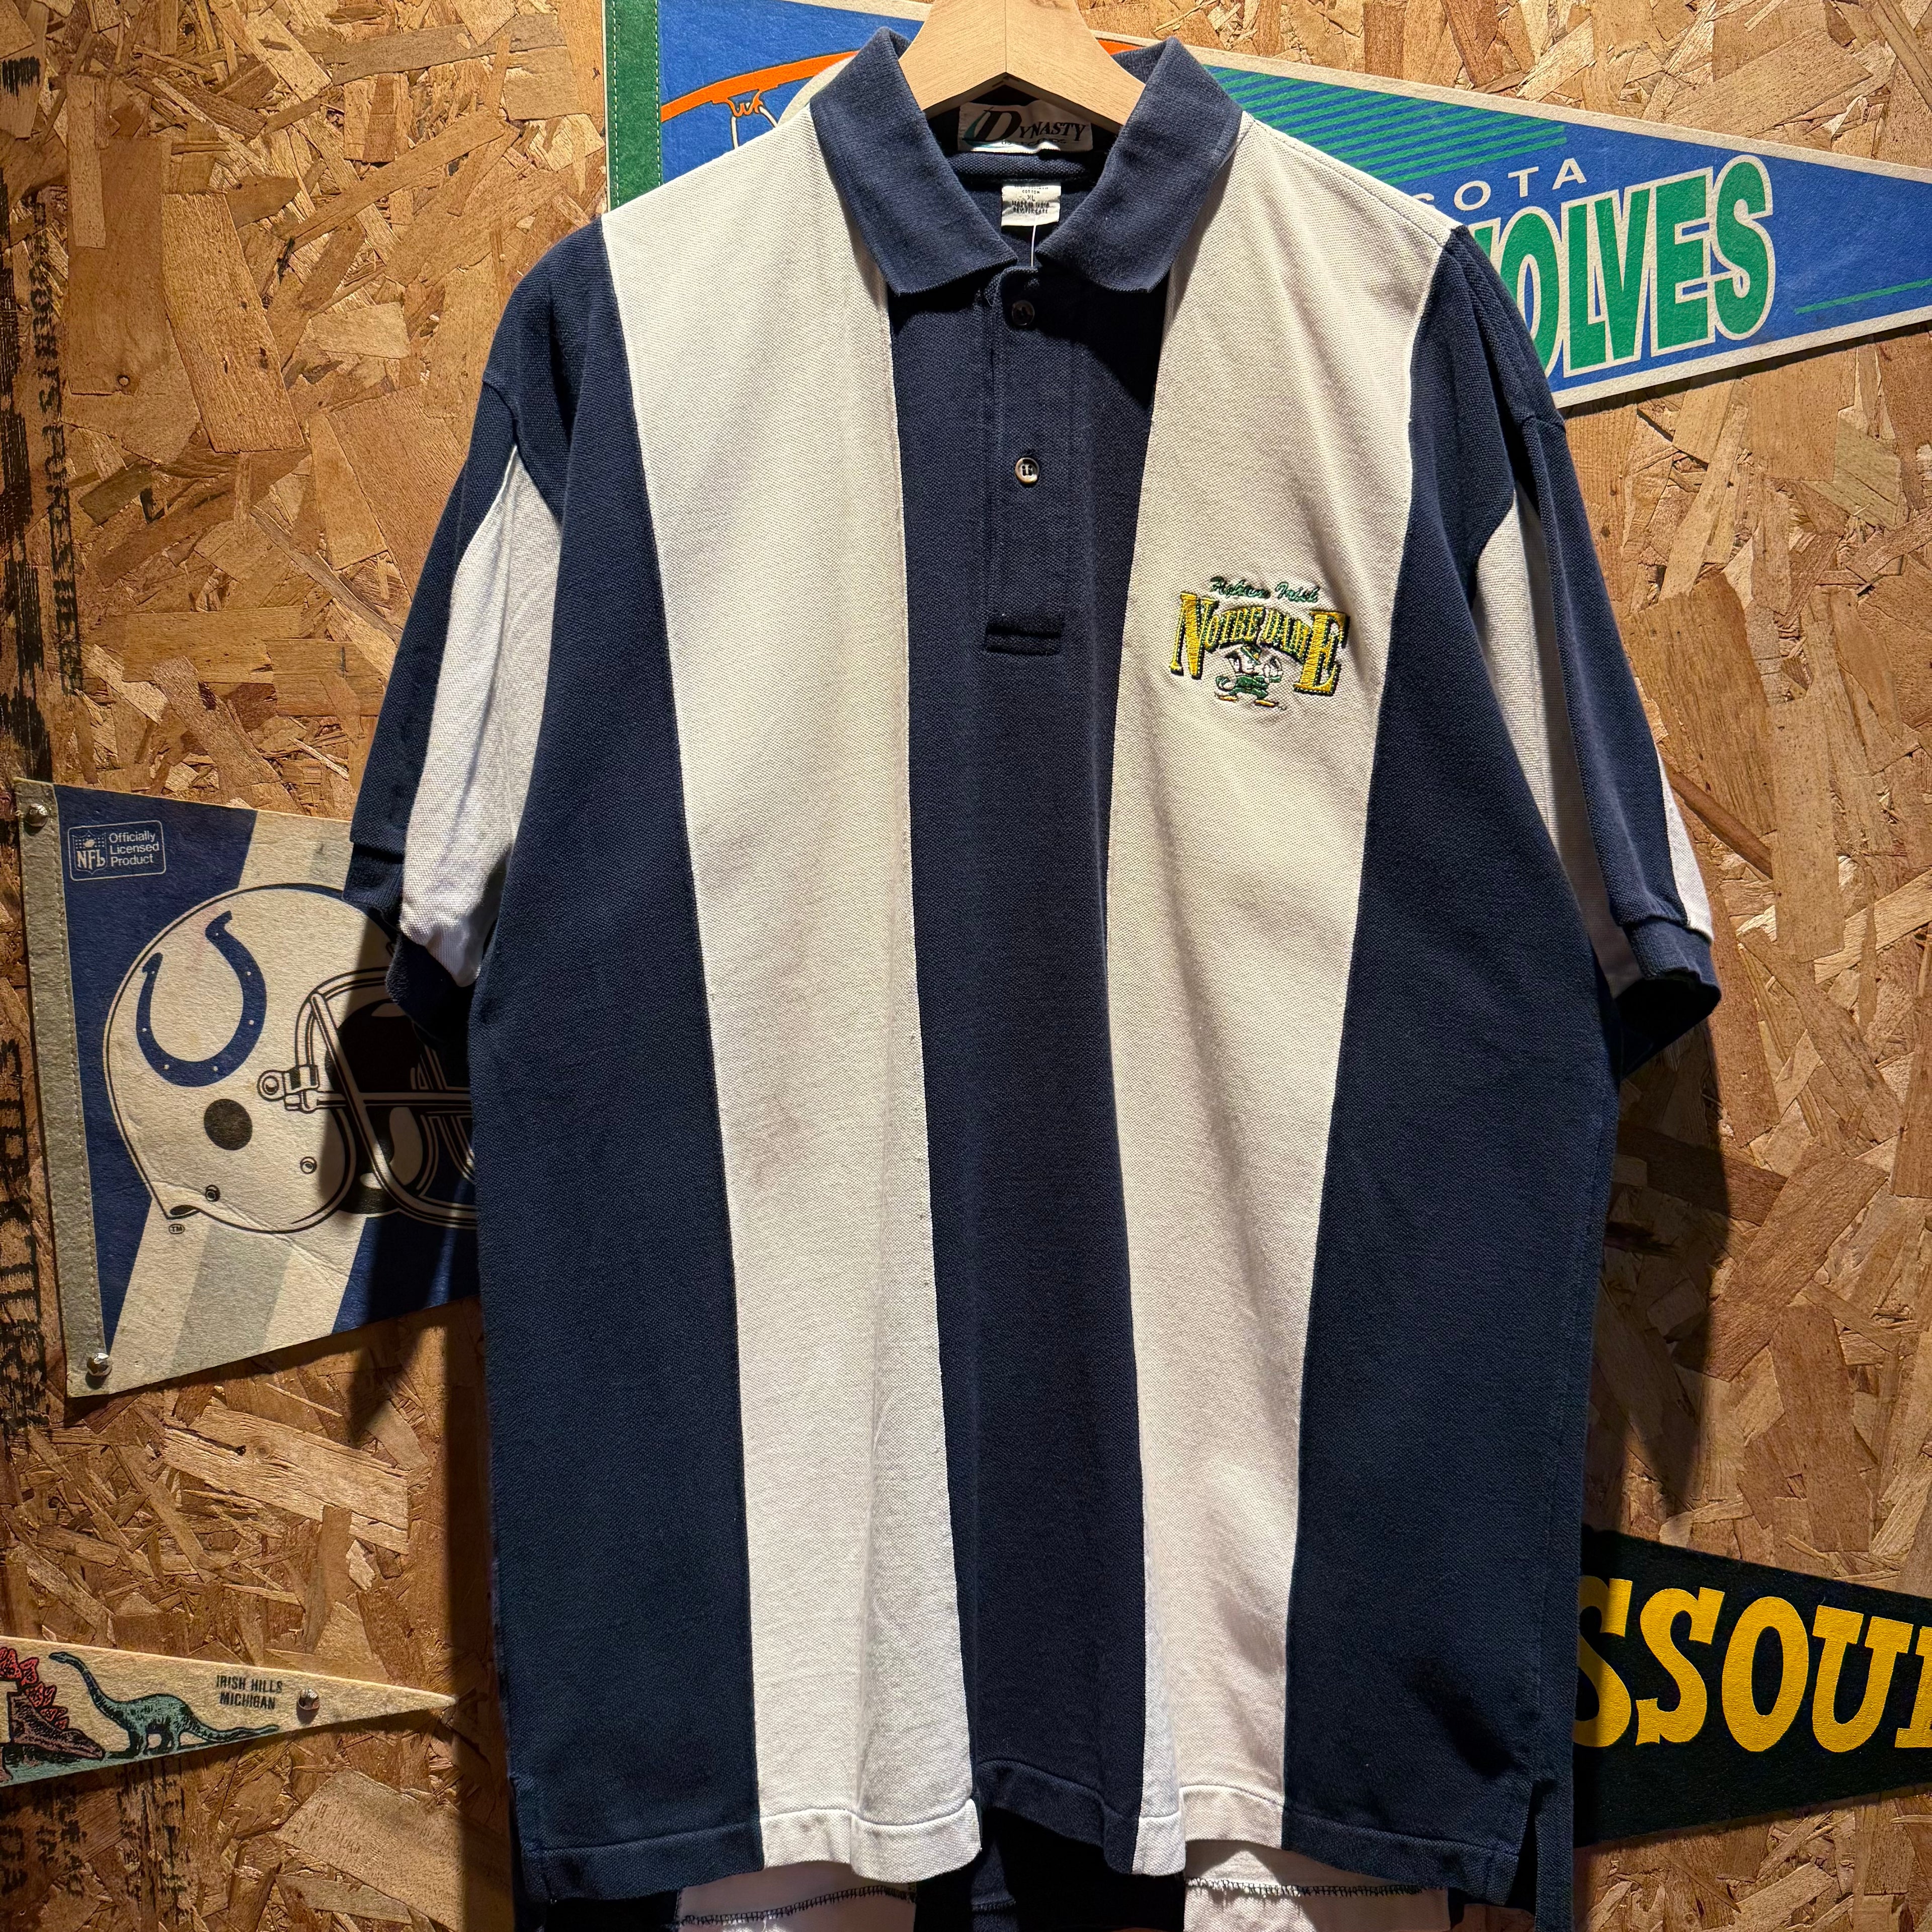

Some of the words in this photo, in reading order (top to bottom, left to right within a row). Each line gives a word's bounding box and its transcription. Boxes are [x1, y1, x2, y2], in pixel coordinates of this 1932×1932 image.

[1474, 154, 1775, 380] OLVES
[109, 831, 155, 843] Officially
[110, 842, 159, 855] Licensed
[76, 849, 106, 870] NFL
[111, 854, 154, 867] Product
[216, 1675, 246, 1690] IRISH
[251, 1678, 283, 1693] HILLS
[219, 1692, 275, 1710] MICHIGAN
